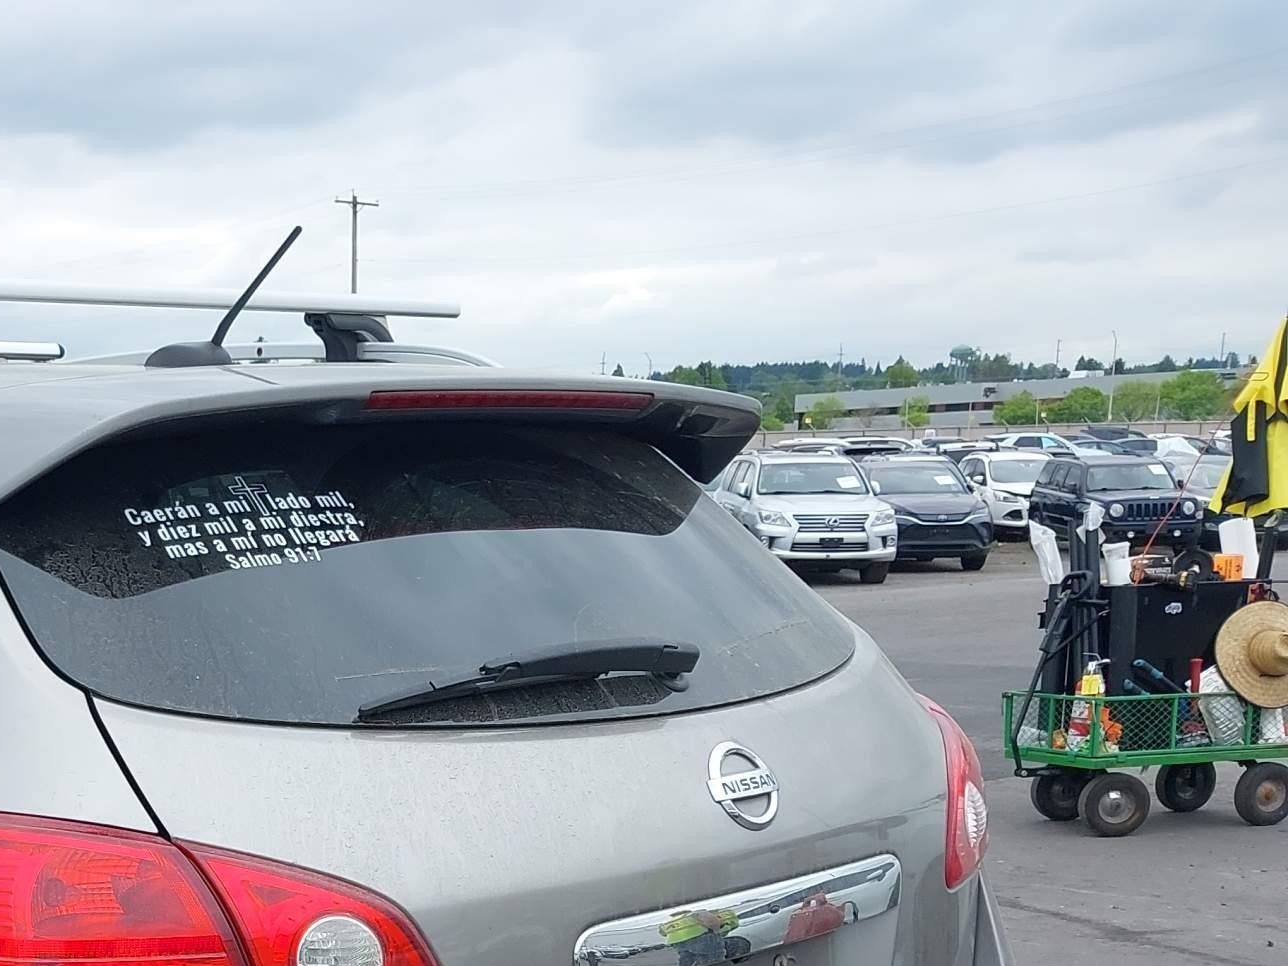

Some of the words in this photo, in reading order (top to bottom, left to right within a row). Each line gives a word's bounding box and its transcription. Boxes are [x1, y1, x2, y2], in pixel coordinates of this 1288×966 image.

[124, 501, 201, 526] Caerán
[204, 502, 219, 516] a
[223, 496, 252, 514] mi
[267, 492, 310, 510] lado
[315, 491, 355, 509] mil,
[138, 529, 152, 547] y
[157, 522, 201, 543] diez
[204, 516, 238, 536] mil
[242, 517, 257, 532] a
[259, 512, 287, 530] mi
[289, 508, 365, 530] diestra,
[165, 542, 209, 561] mas
[212, 538, 228, 553] a
[230, 531, 257, 551] mí
[263, 531, 288, 548] no
[288, 524, 361, 546] llegará
[225, 552, 283, 571] Salmo
[285, 546, 322, 564] 91:7
[722, 774, 776, 795] NISSAN
